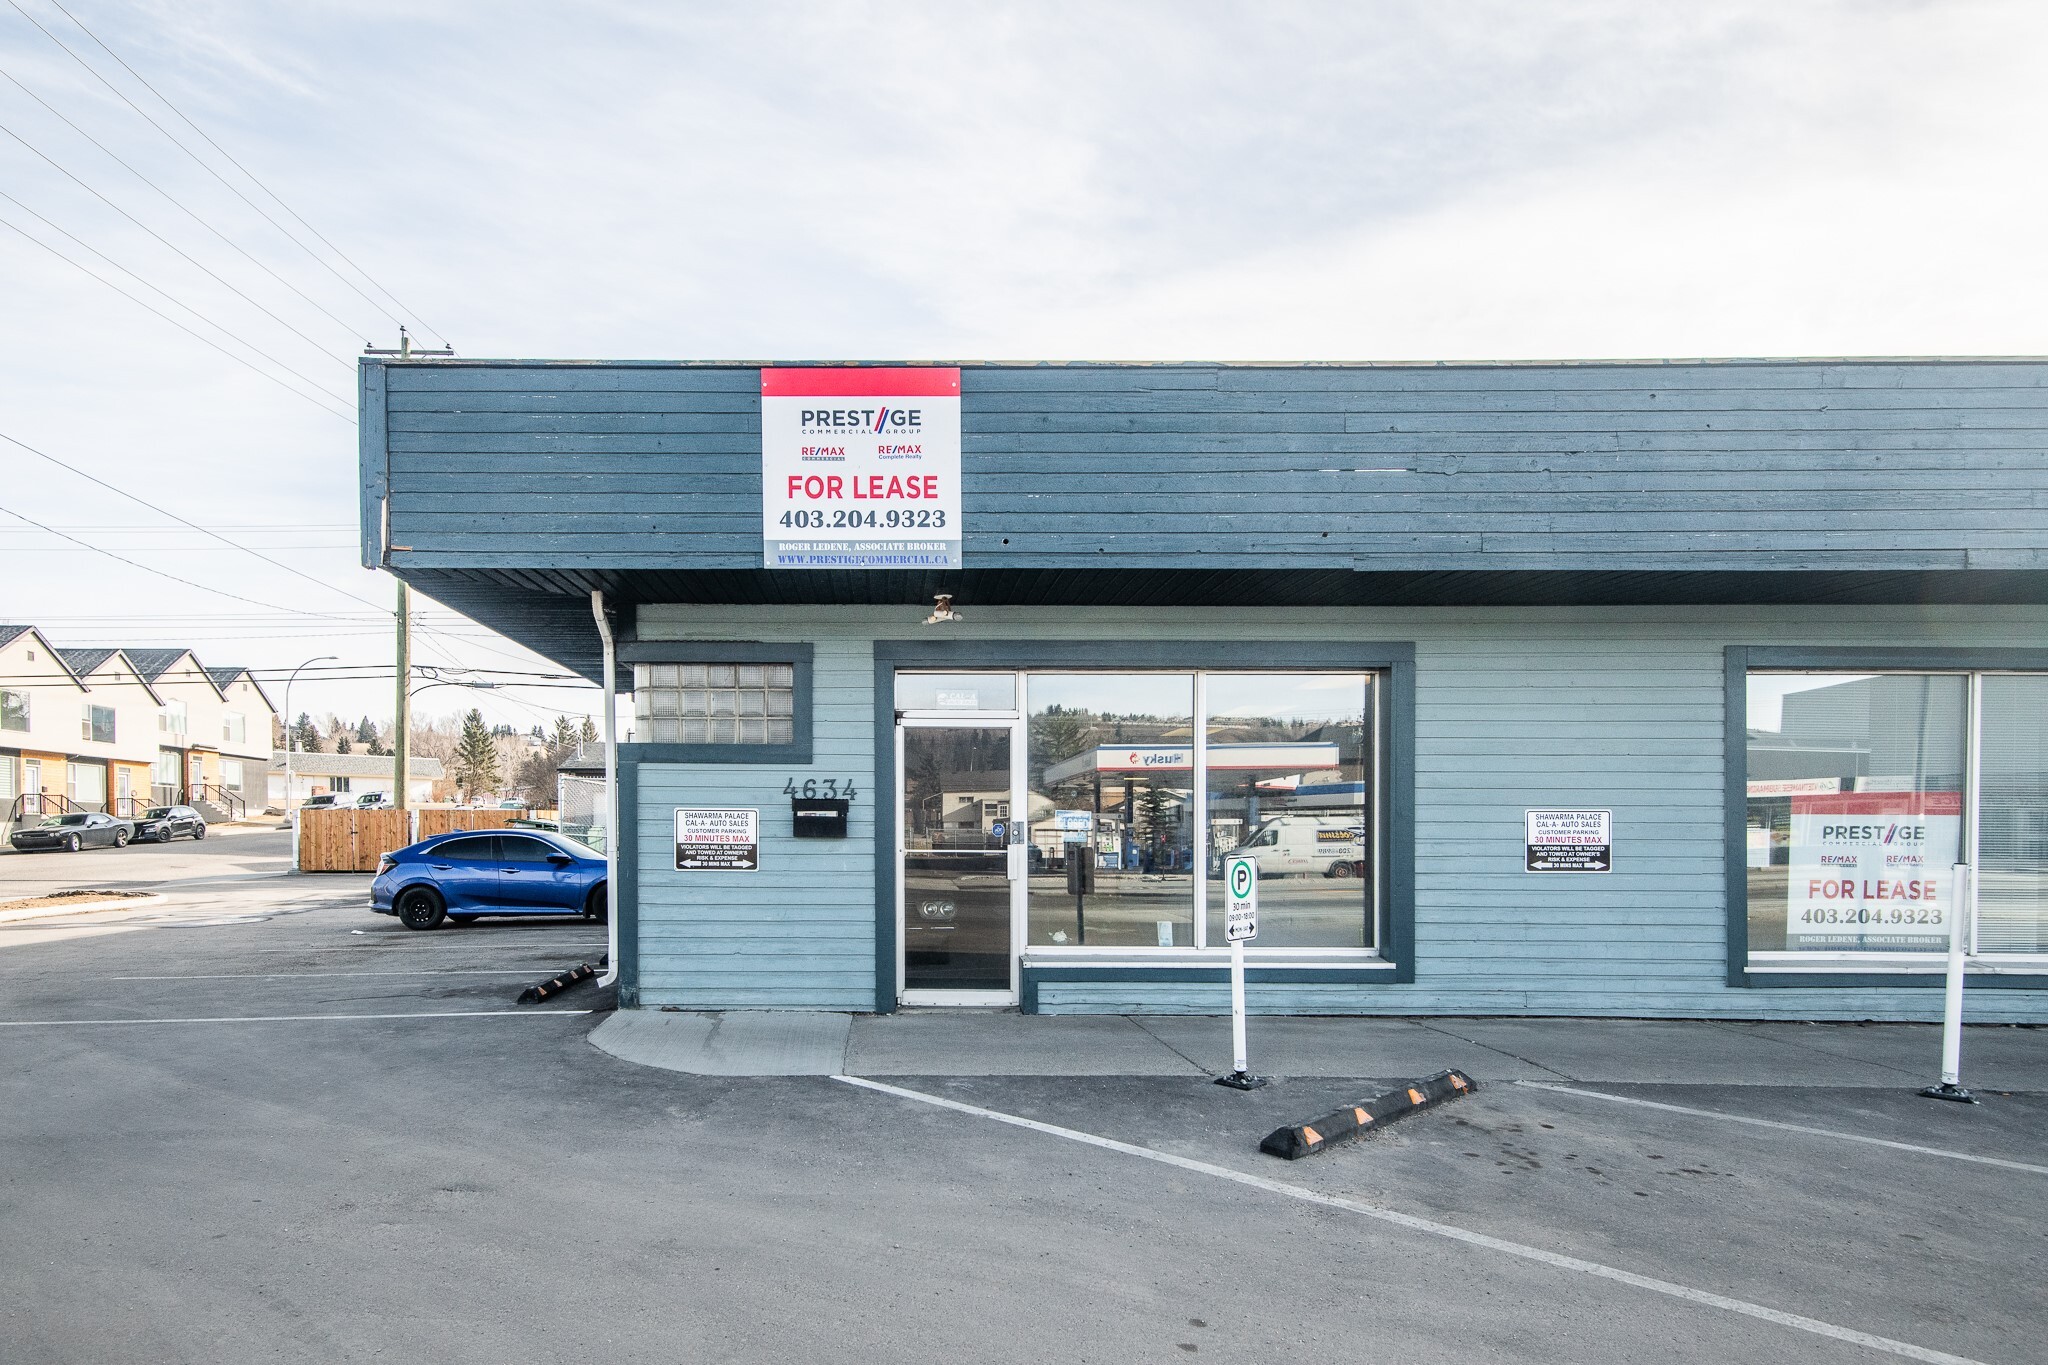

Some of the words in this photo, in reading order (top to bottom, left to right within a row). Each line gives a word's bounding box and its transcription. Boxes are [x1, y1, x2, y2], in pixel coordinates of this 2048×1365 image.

[801, 446, 845, 456] RE/MAX
[878, 444, 922, 454] RE/MAX
[788, 475, 843, 499] FOR
[853, 475, 939, 499] LEASE
[779, 509, 946, 528] 403.204.9323
[779, 542, 812, 551] ROGER
[813, 542, 852, 552] LEDENE,
[854, 542, 905, 551] ASSOCIATE
[906, 542, 947, 551] BROKER
[777, 554, 948, 565] WWW.PRESTIGECOMMERCIAL.CA
[782, 777, 858, 800] 4634
[709, 819, 727, 827] AUTO
[683, 834, 693, 842] 30
[695, 834, 730, 842] MINUTES
[732, 835, 750, 843] MAX
[1534, 836, 1544, 844] 30
[1545, 836, 1582, 844] MINUTES
[1584, 836, 1602, 844] MAX
[1820, 855, 1858, 863] RE/MAX
[1886, 855, 1924, 863] RE/MAX
[1237, 869, 1247, 891] P
[1808, 879, 1855, 900] FOR
[1863, 879, 1937, 901] LEASE
[1232, 902, 1240, 911] 30
[1240, 901, 1251, 910] min
[1800, 908, 1943, 925] 403.204.9323
[1799, 935, 1826, 943] ROGER
[1827, 935, 1860, 944] LEDENE,
[1862, 936, 1906, 944] ASSOCIATE
[1907, 936, 1942, 944] BROKER
